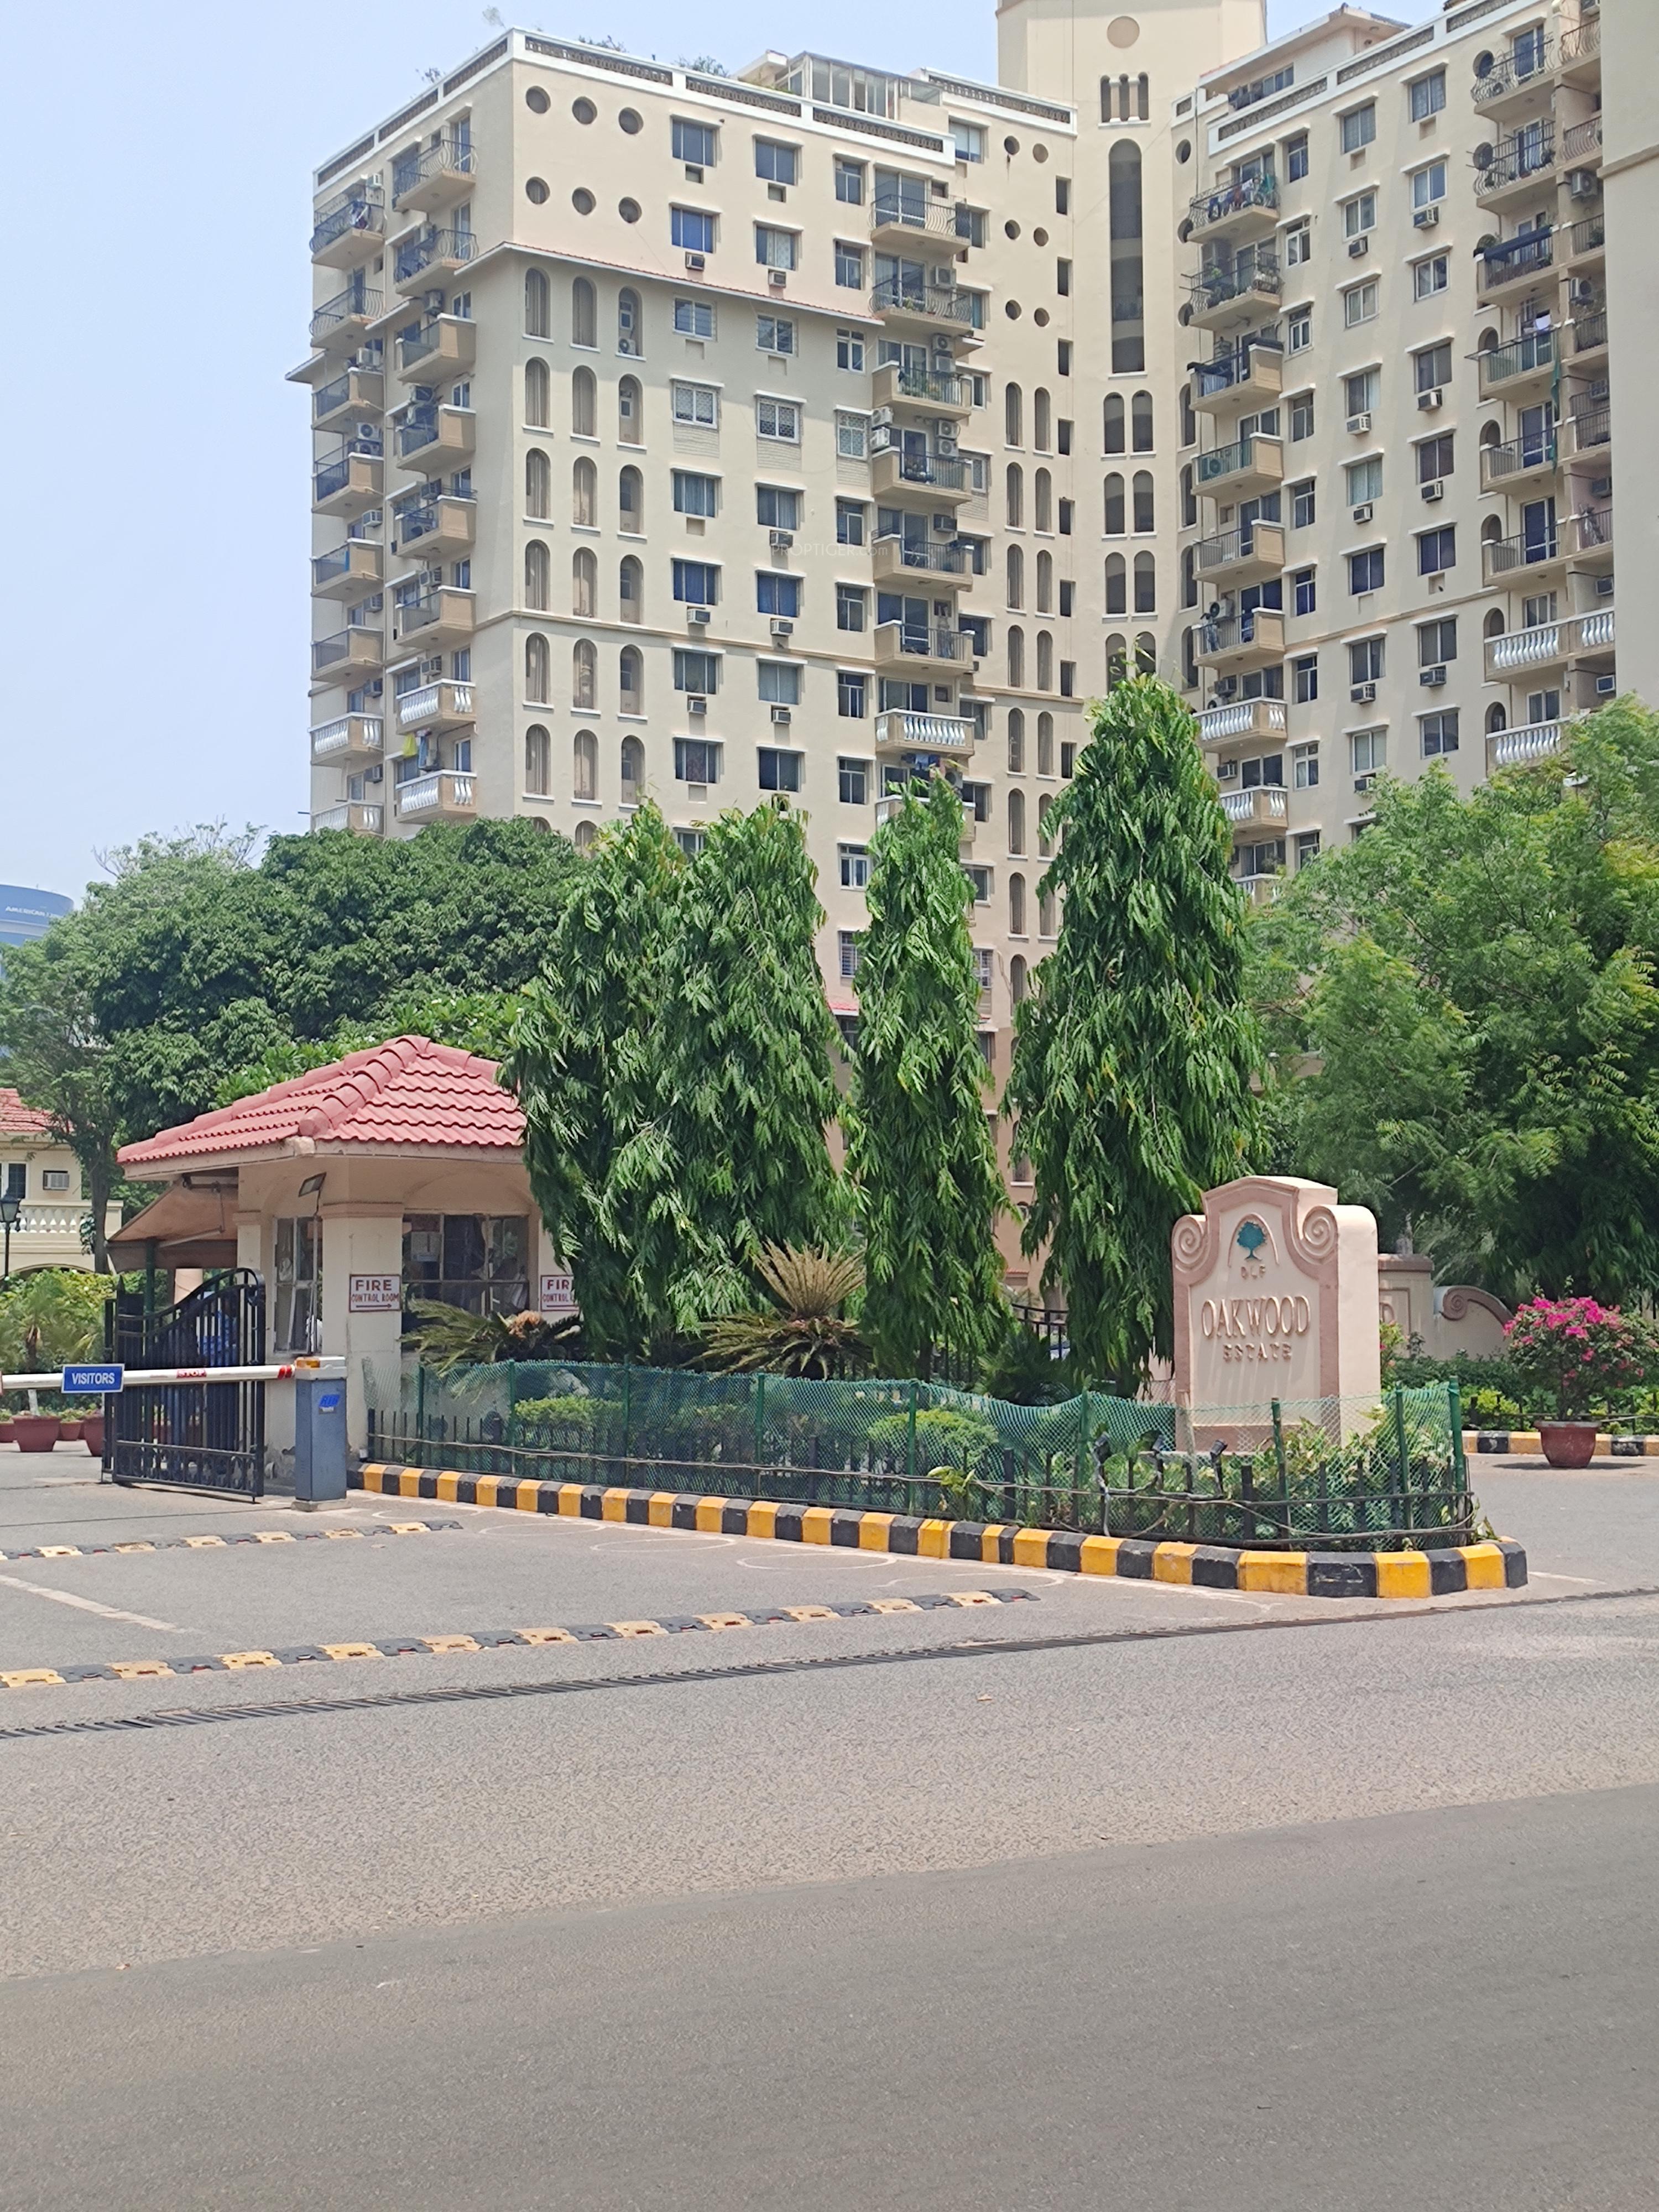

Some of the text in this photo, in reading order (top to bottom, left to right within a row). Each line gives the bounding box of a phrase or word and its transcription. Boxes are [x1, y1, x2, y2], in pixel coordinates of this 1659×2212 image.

[356, 1279, 392, 1291] FIRE
[547, 1279, 570, 1290] FIR
[351, 1293, 399, 1302] CONTROL ROOM
[542, 1293, 568, 1302] CONTROL
[1202, 1295, 1311, 1338] OAKWOOD
[1223, 1342, 1292, 1362] ESTATE
[71, 1372, 115, 1385] VISITORS
